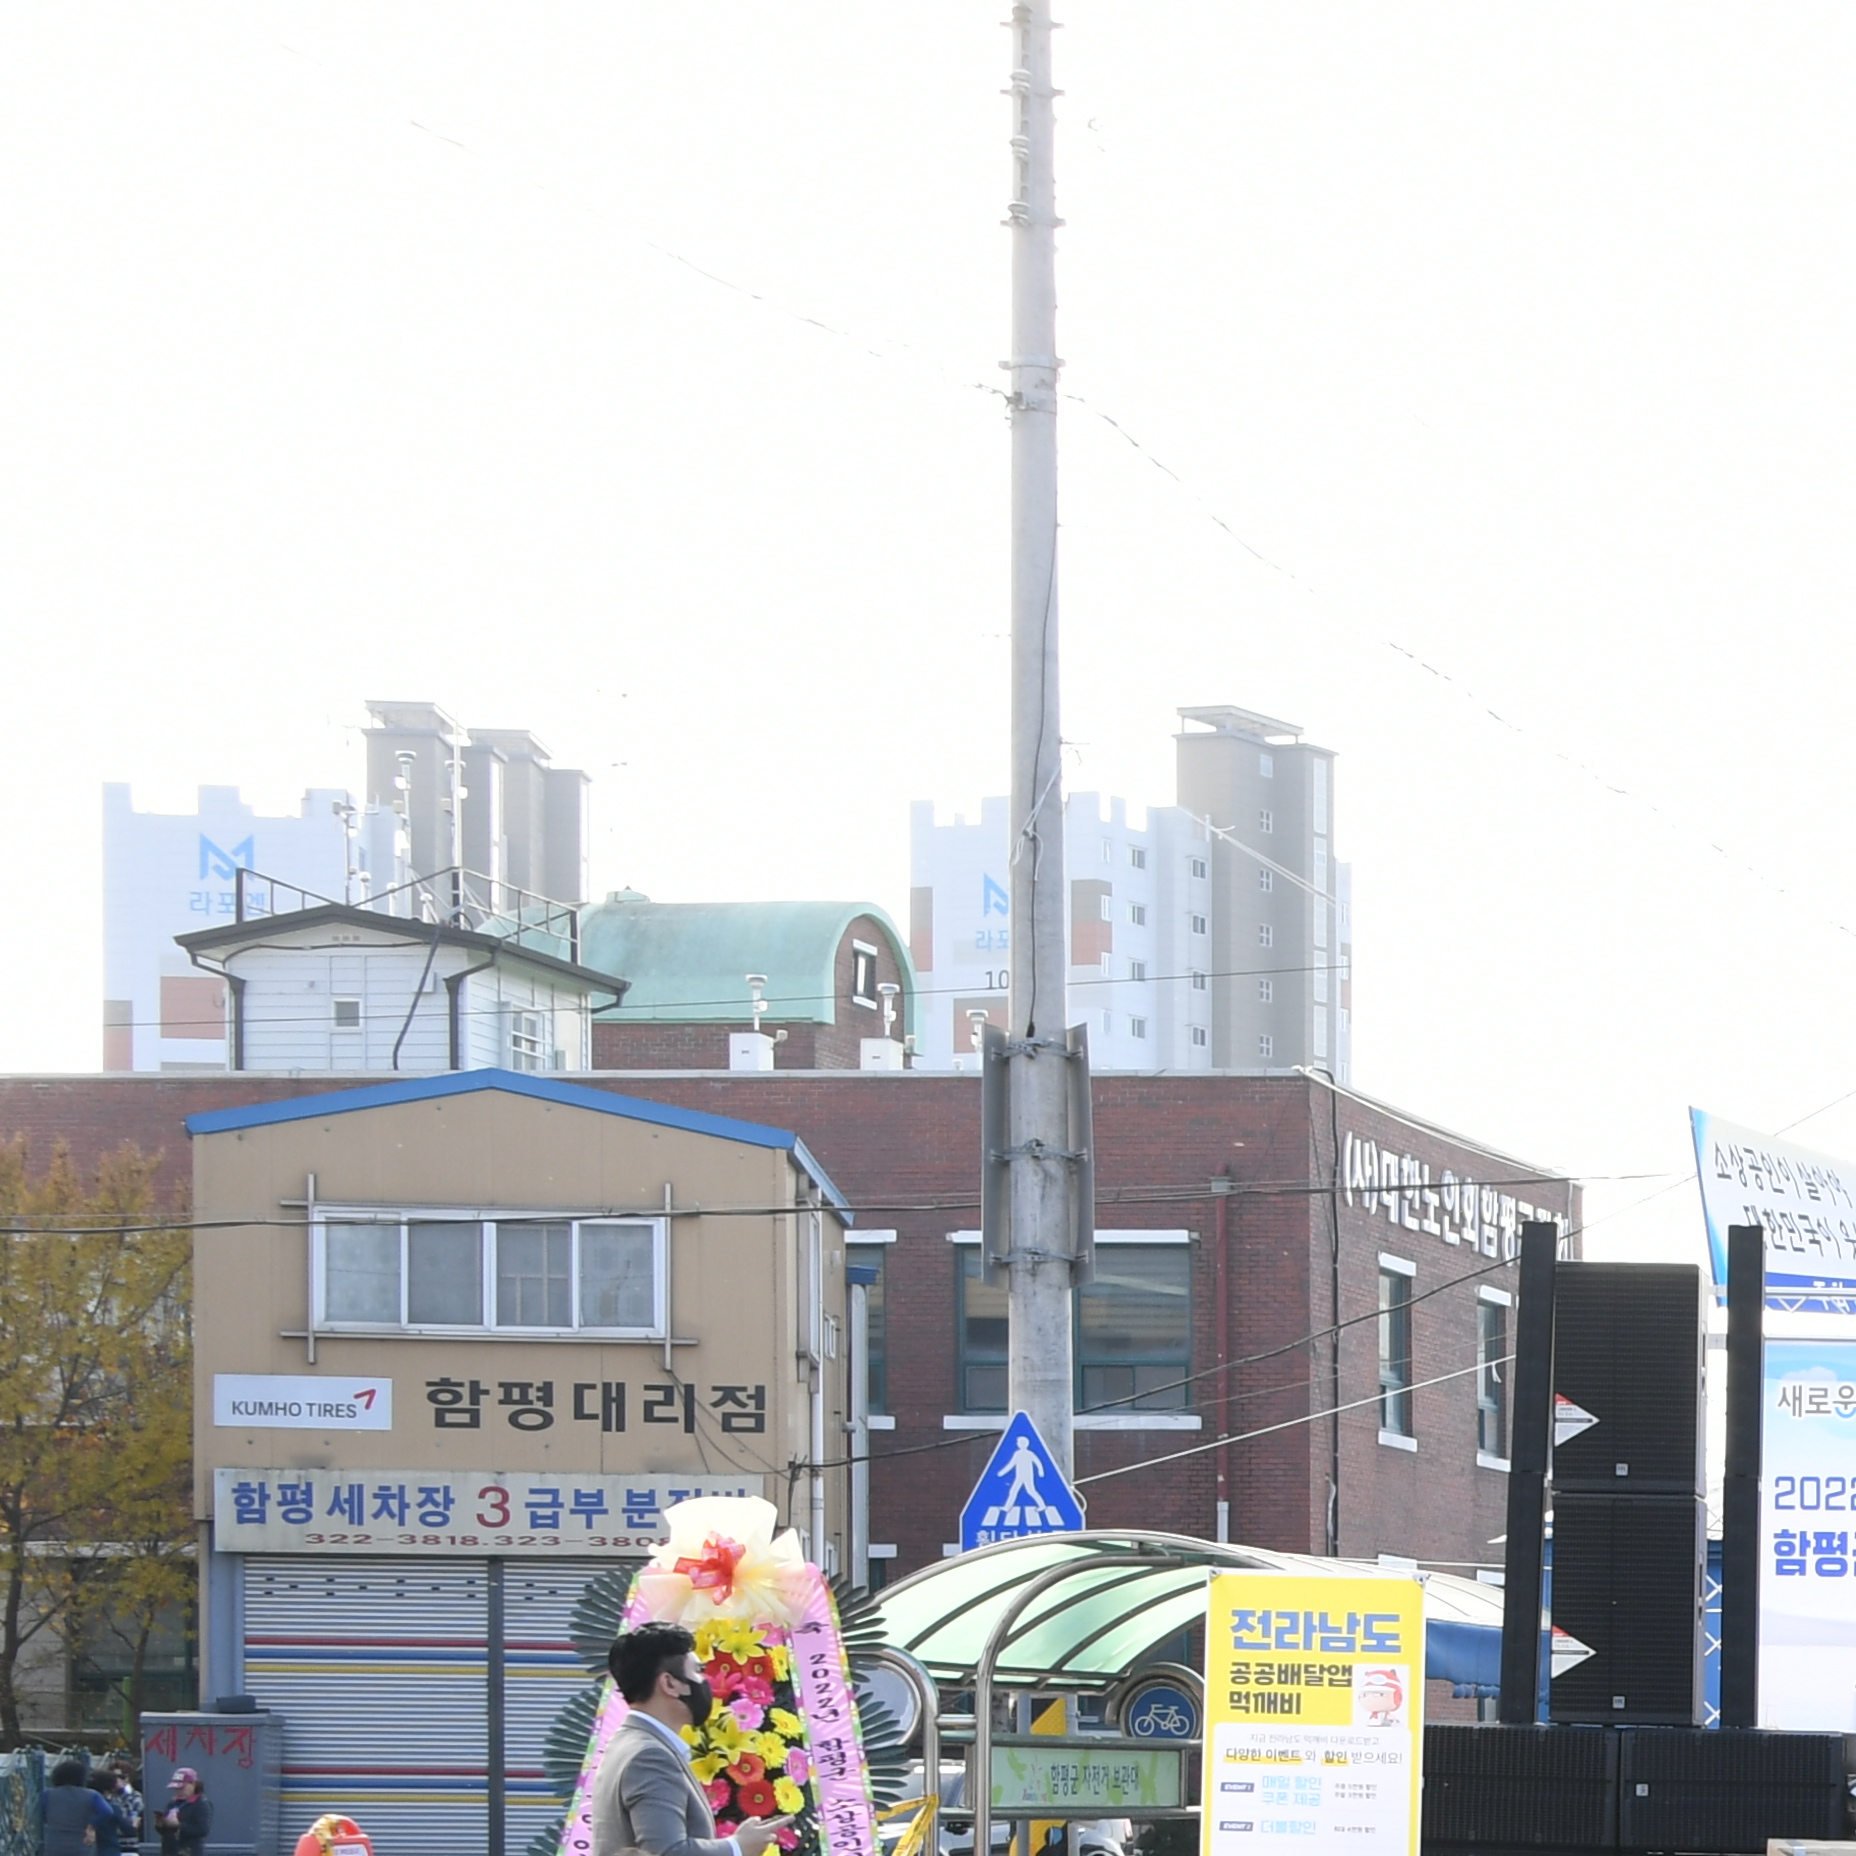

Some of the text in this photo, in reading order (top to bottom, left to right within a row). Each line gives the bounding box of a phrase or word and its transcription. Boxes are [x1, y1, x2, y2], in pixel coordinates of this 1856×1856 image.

[231, 1400, 358, 1420] KUMHO TIRES
[425, 1377, 767, 1435] 함평대리점
[231, 1480, 315, 1527] 함평
[326, 1484, 456, 1527] 세차장
[475, 1485, 512, 1529] 3
[1230, 1609, 1402, 1654] 전라남도
[1229, 1661, 1354, 1688] 공공배달앱
[1229, 1690, 1302, 1716] 먹깨비
[146, 1726, 256, 1769] 세차장
[1225, 1747, 1403, 1765] 다양한 이벤트 와 할인 받으세요!
[1050, 1763, 1080, 1797] 함평군
[1082, 1764, 1110, 1796] 자전거
[1112, 1764, 1140, 1796] 보관대
